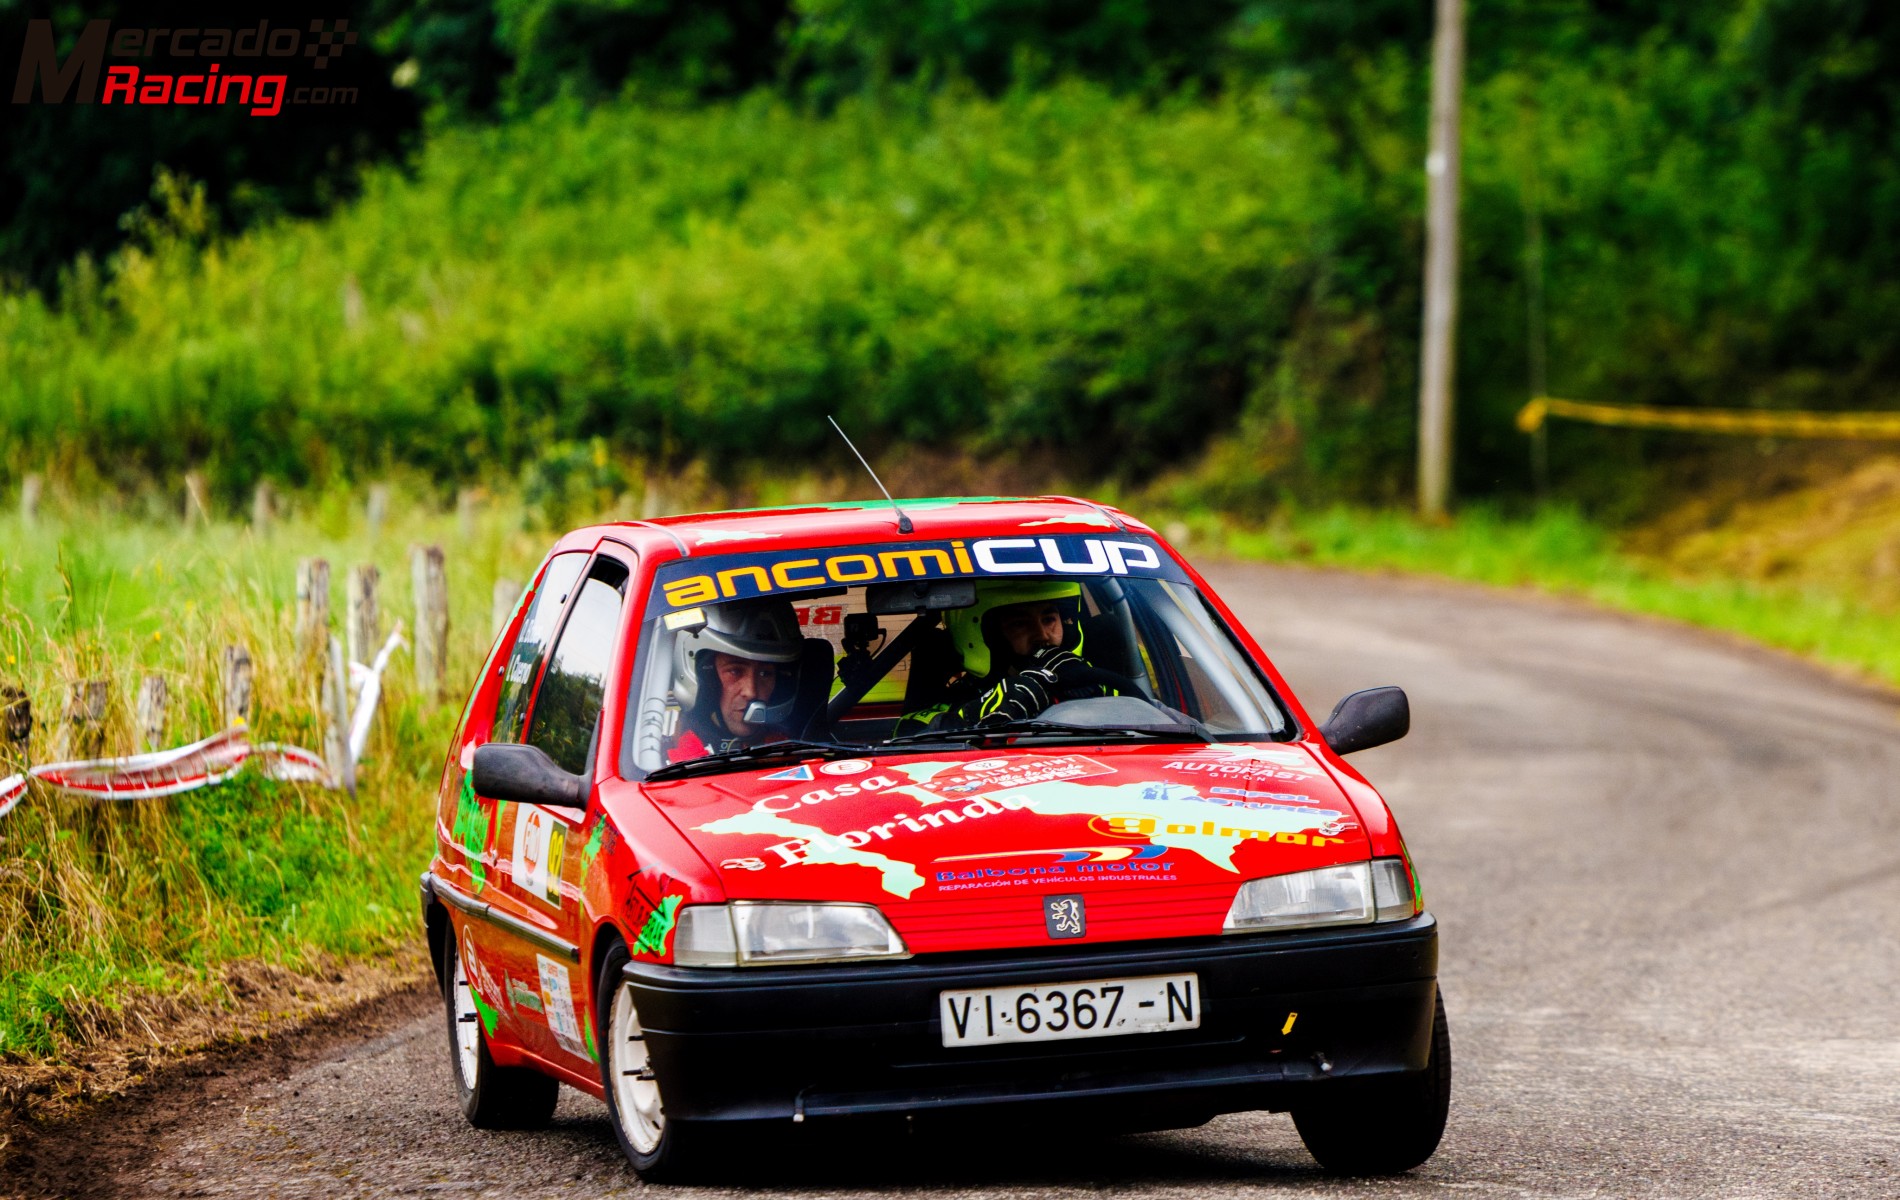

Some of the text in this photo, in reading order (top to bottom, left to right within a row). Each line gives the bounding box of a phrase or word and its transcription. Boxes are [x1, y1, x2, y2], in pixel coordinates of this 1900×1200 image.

[951, 757, 1078, 783] RALLYSPRINT
[1162, 761, 1312, 781] AUTOFAST
[751, 774, 898, 814] Casa
[764, 792, 1040, 868] Florinda
[935, 862, 1175, 882] Balbona motor
[938, 879, 1011, 892] REPARACIÓN
[1014, 878, 1029, 886] DE
[1032, 875, 1095, 884] VEHÍCULOS
